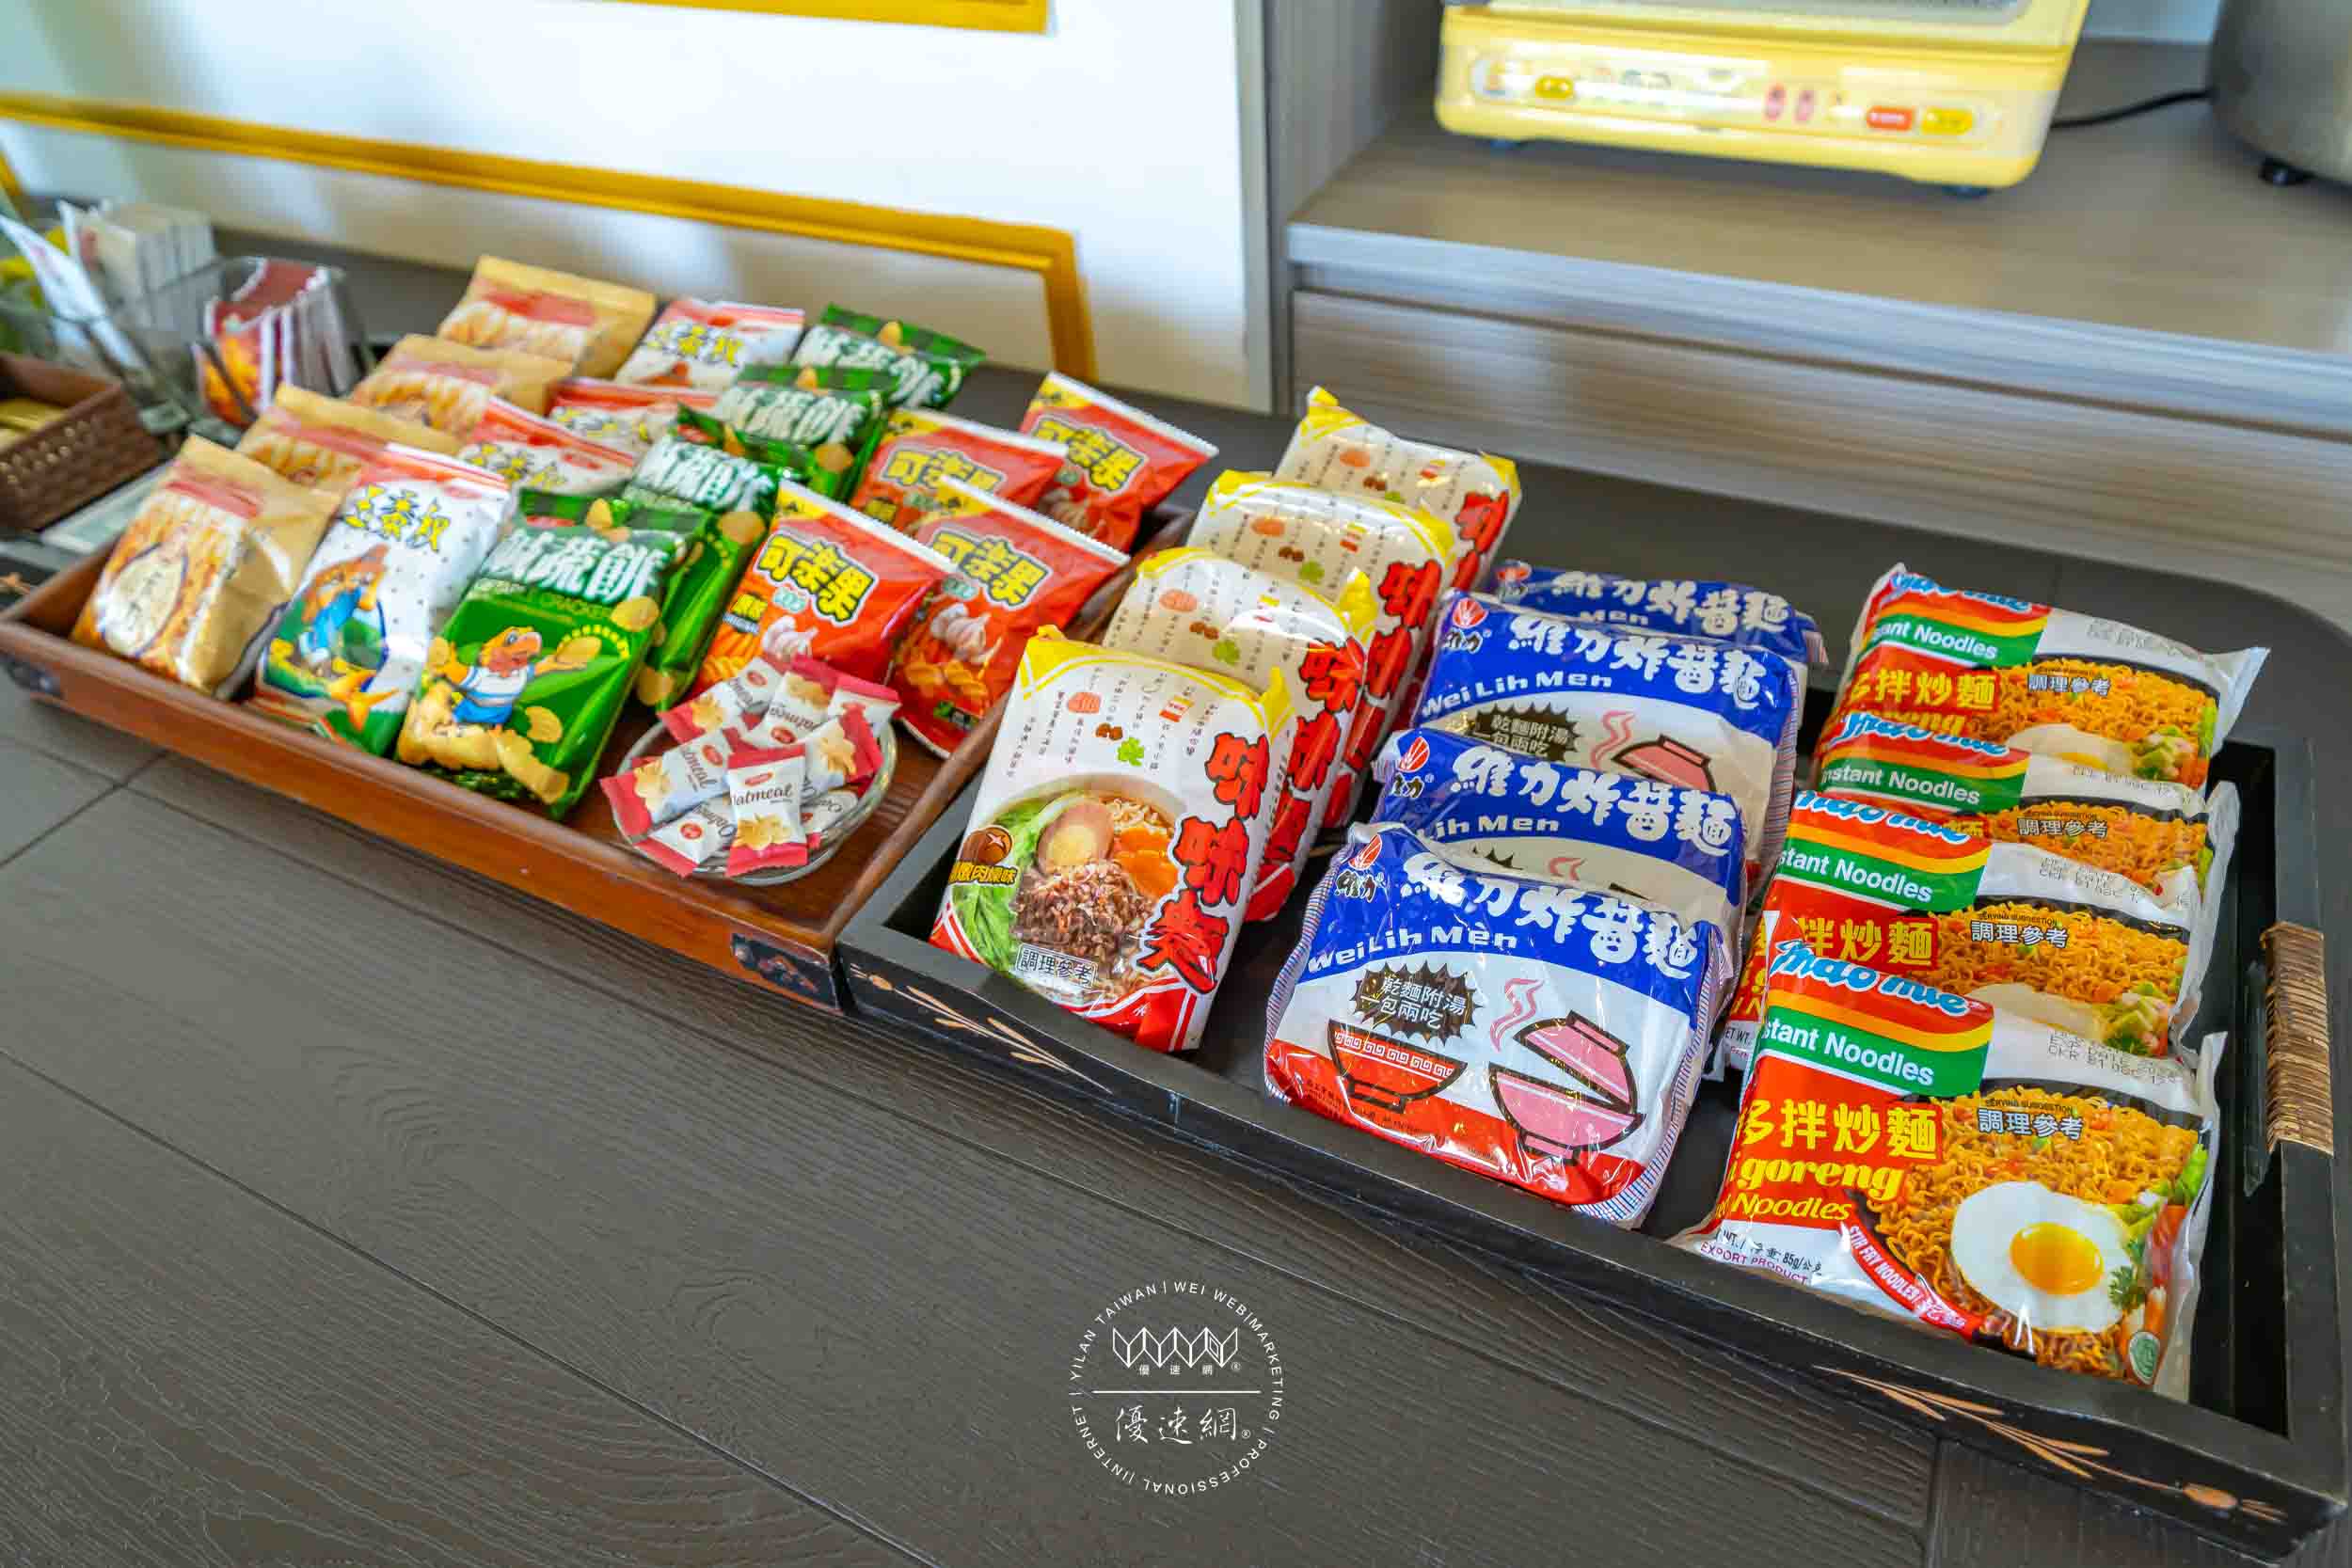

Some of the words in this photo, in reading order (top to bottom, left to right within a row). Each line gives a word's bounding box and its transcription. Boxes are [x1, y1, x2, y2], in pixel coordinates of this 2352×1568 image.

[1551, 570, 1789, 637] 維力炸醬麵
[1508, 614, 1769, 709] 維力炸醬麵
[1913, 623, 1998, 659] Noodles
[1422, 686, 1470, 717] Wei
[1474, 674, 1529, 699] Lih
[1535, 671, 1613, 689] Men
[2028, 673, 2110, 697] 調理參考
[1450, 745, 1738, 857] 維力炸醬麵
[1887, 770, 1980, 805] Noodles
[1478, 814, 1561, 833] Men
[2017, 817, 2108, 840] 調理參考
[1835, 860, 1933, 904] Noodles
[1400, 851, 1699, 979] 維力炸醬麵
[1970, 921, 2069, 950] 調理參考
[1020, 948, 1093, 986] 調理參考
[1308, 942, 1365, 974] Wei
[1368, 927, 1422, 953] Lih
[1431, 925, 1518, 950] Men
[1360, 993, 1444, 1030] 一包兩吃
[1381, 974, 1468, 1016] 乾麵附湯
[1824, 1031, 1934, 1085] Noodles
[1978, 1108, 2083, 1142] 調理參考
[1737, 1159, 1905, 1201] goreng
[1730, 1192, 1852, 1221] Noodles
[1701, 1241, 1748, 1264] EXPORT
[1751, 1257, 1808, 1286] PRODUCT
